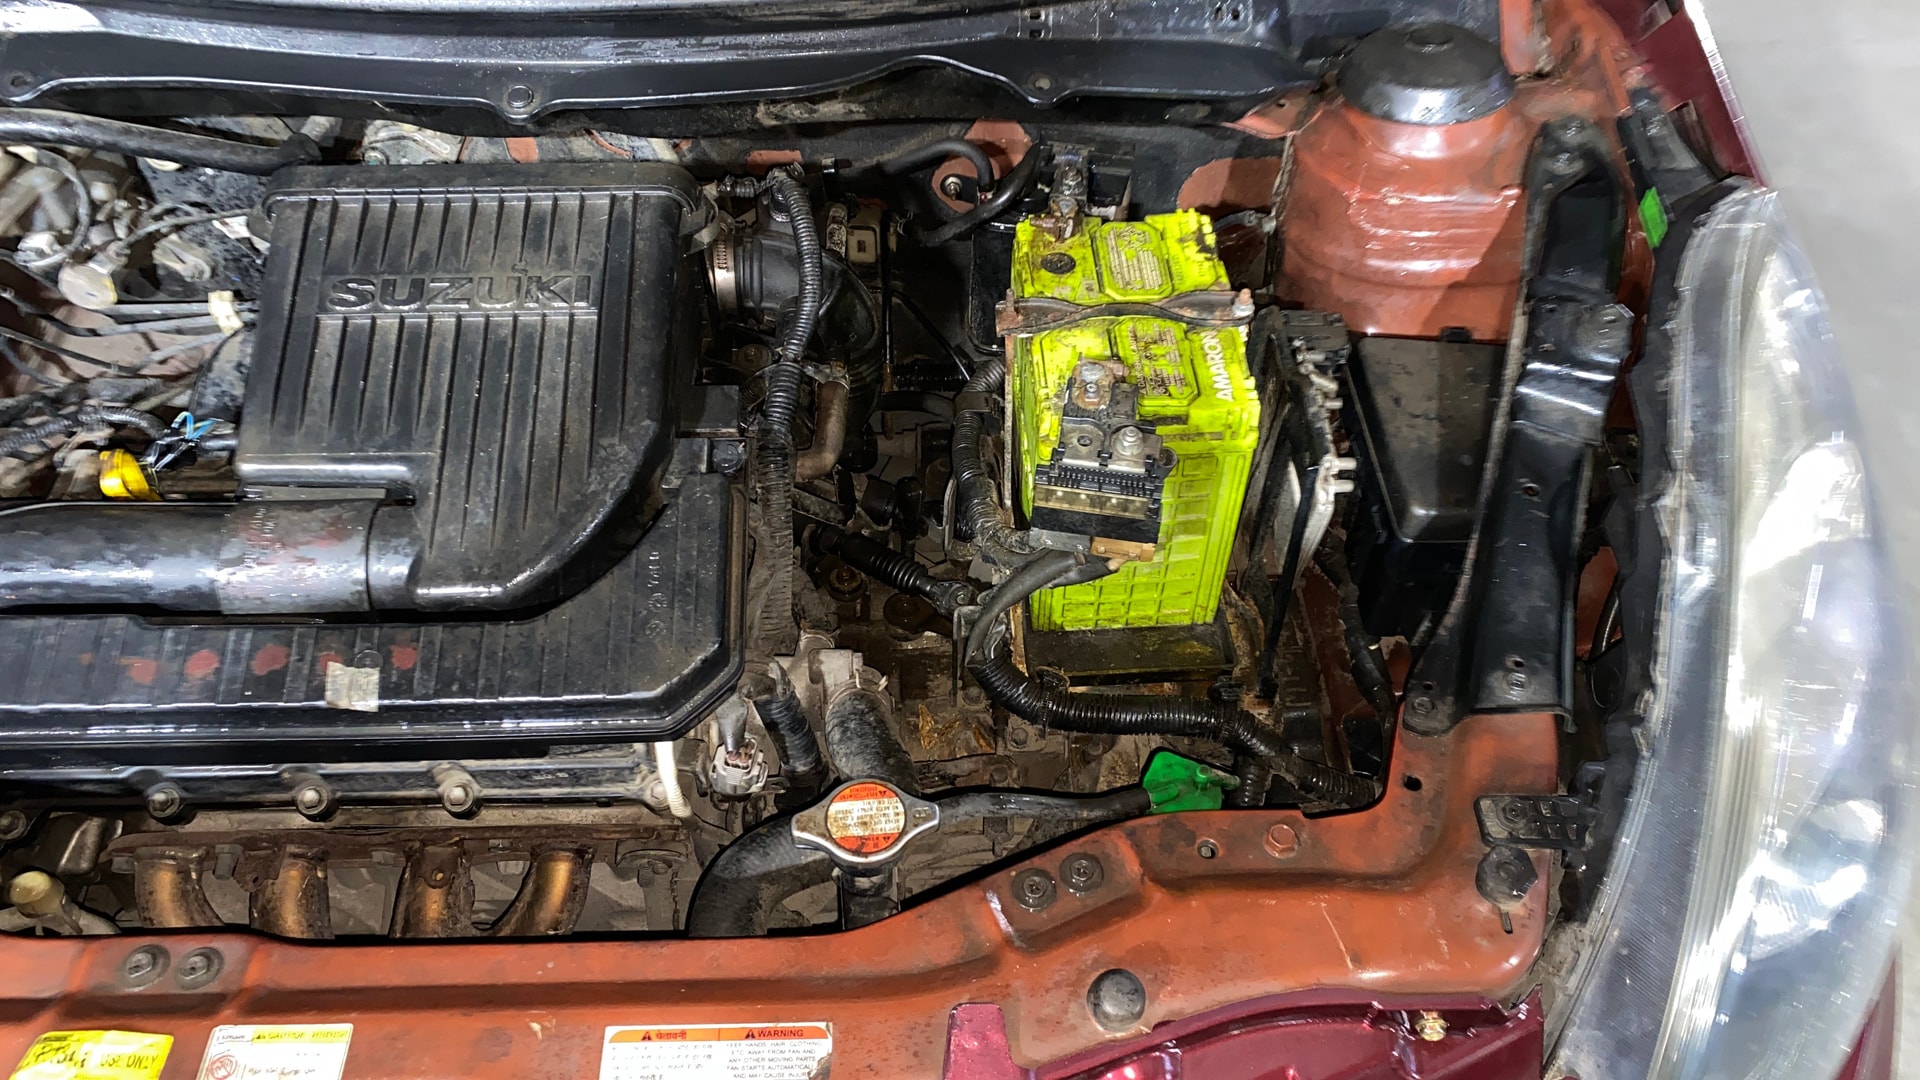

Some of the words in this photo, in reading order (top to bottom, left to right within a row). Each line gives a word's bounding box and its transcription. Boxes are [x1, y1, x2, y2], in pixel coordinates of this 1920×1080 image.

[327, 275, 592, 311] SUZUKI
[1201, 330, 1234, 402] AMARON
[655, 1029, 687, 1040] चेतावनी
[757, 1029, 804, 1038] WARNING
[126, 1054, 160, 1069] ONLY
